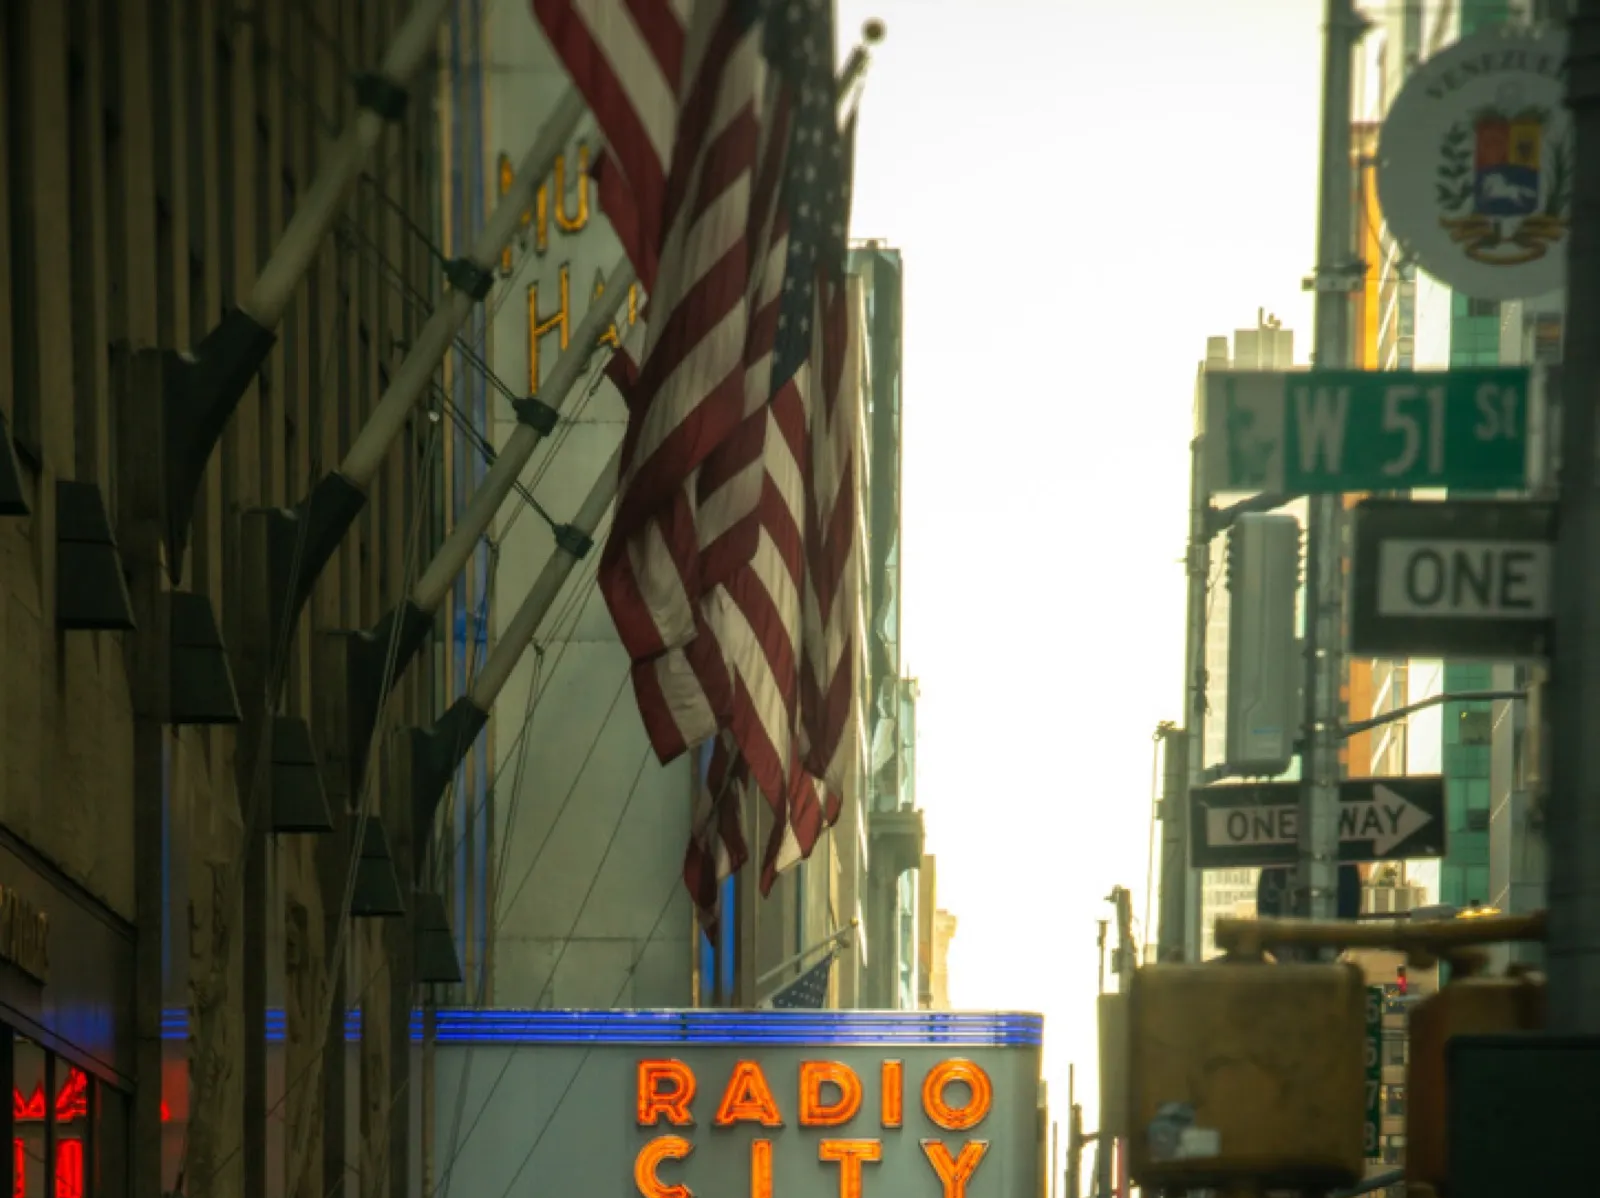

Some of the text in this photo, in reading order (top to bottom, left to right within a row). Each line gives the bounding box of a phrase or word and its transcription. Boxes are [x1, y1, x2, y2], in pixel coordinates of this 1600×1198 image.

[1295, 383, 1518, 476] W 51 St
[1406, 548, 1536, 609] ONE
[1227, 803, 1406, 841] ONE WAY
[636, 1057, 994, 1131] RADIO
